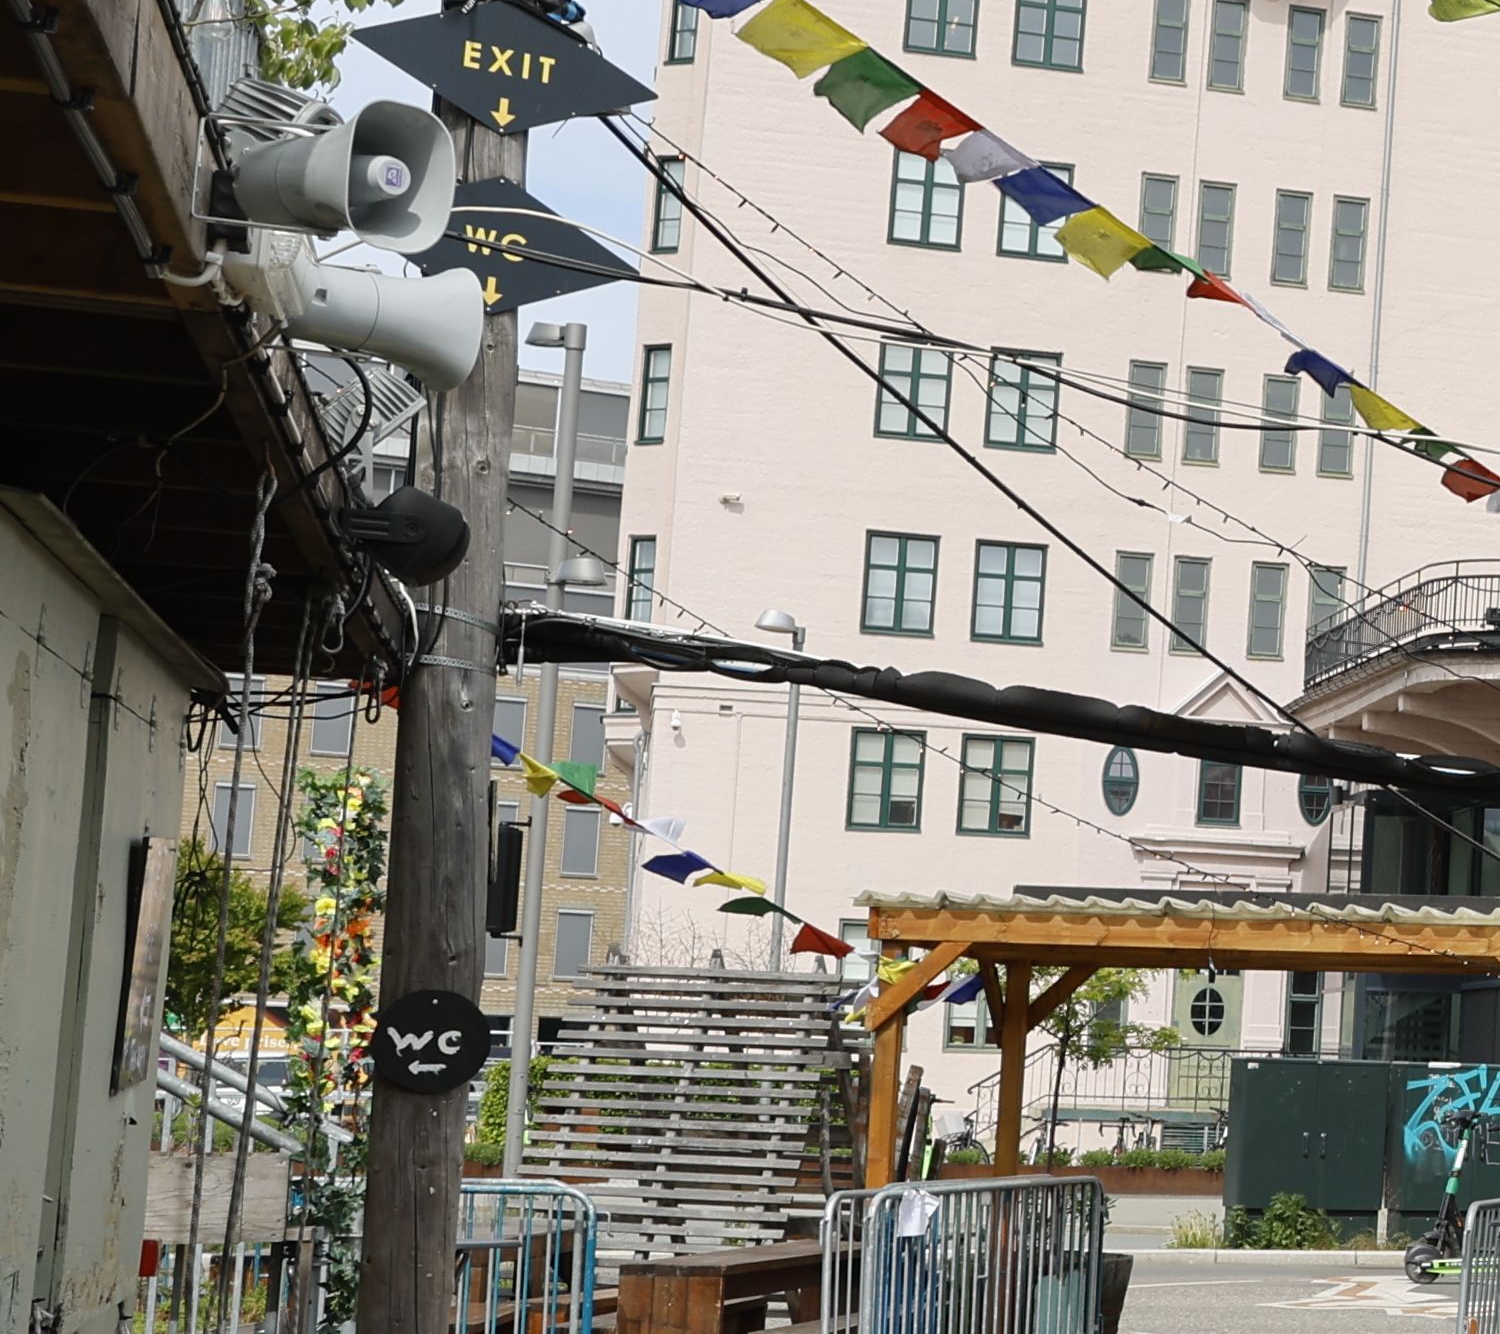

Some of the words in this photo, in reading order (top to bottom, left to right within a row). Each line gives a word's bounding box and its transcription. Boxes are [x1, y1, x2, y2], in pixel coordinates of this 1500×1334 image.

[462, 39, 557, 85] EXIT
[464, 223, 528, 264] WC
[386, 1026, 463, 1057] WC
